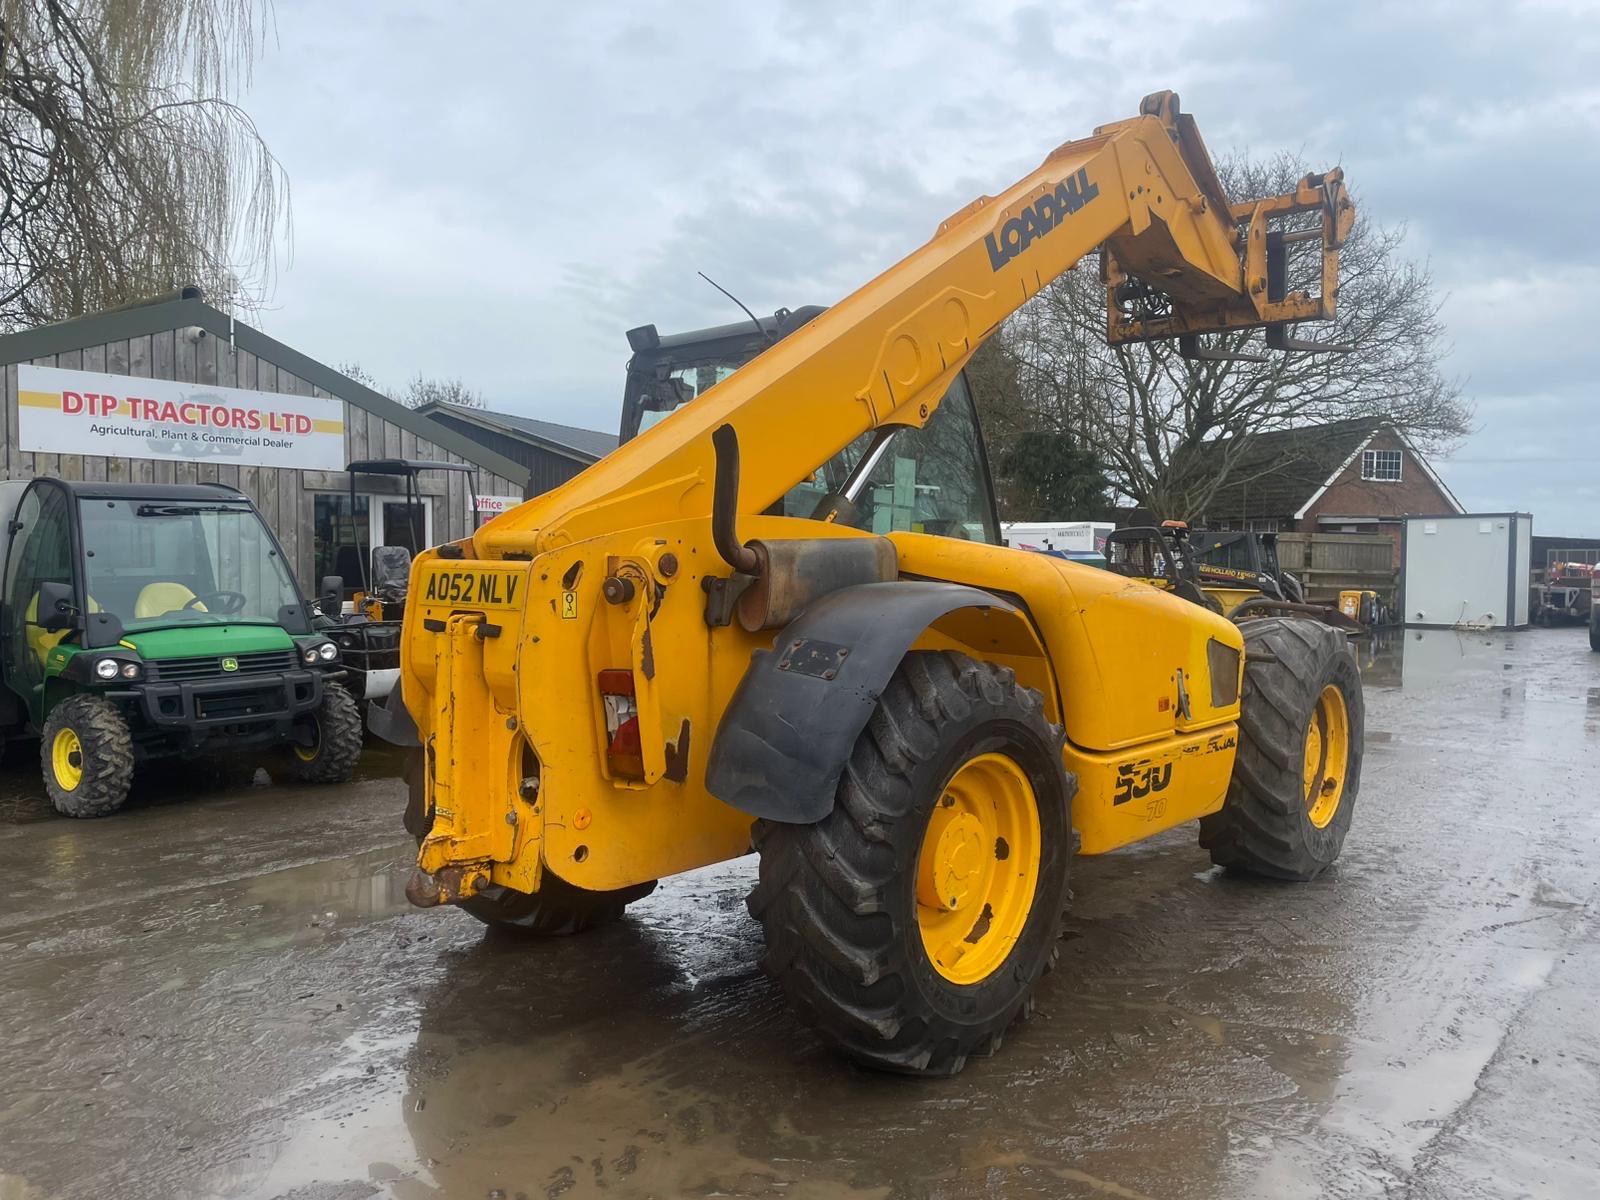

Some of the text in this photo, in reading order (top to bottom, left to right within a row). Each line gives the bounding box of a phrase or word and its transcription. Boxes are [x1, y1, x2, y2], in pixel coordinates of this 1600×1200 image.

[984, 167, 1100, 272] LOADALL
[62, 391, 312, 434] DTP TRACTORS LTD
[90, 424, 293, 448] Agricultural, Plant & Commercial Dealer
[478, 574, 519, 604] NLV
